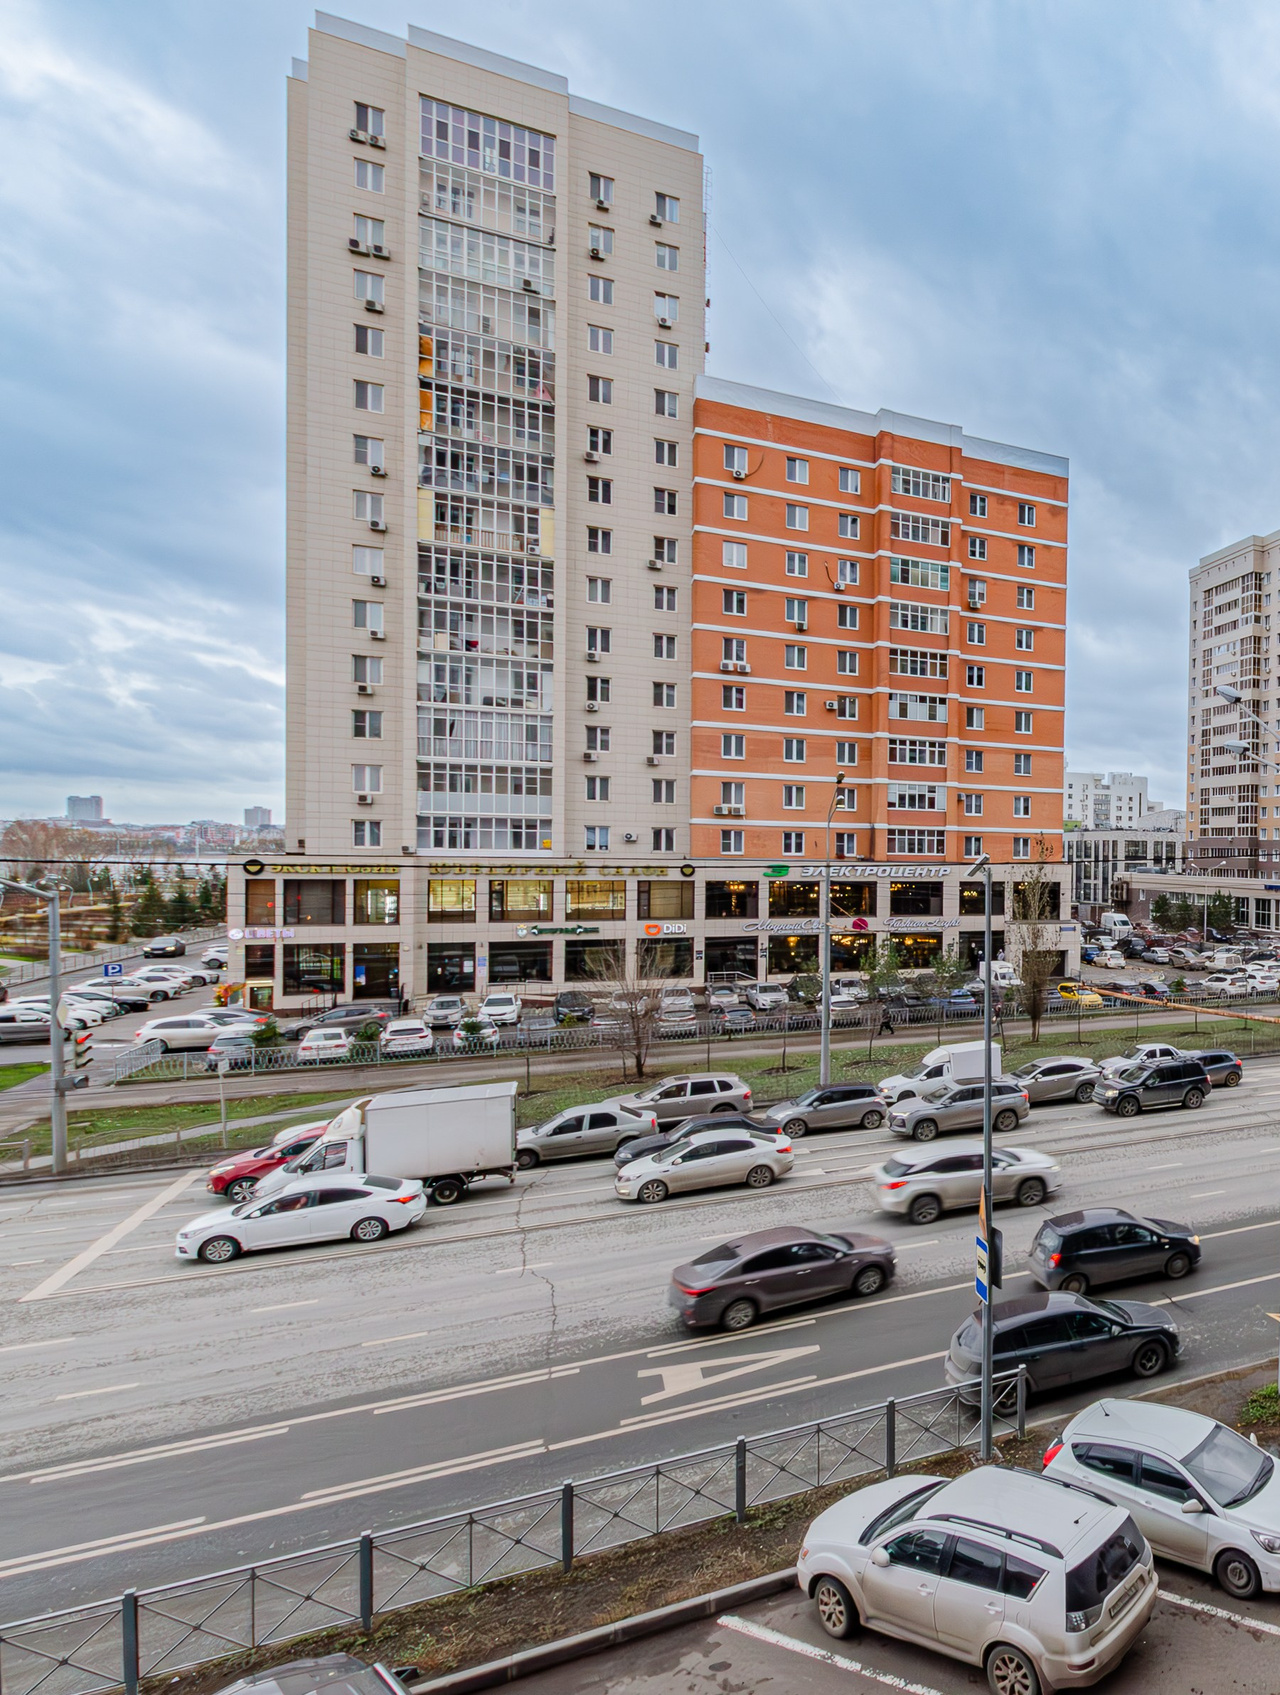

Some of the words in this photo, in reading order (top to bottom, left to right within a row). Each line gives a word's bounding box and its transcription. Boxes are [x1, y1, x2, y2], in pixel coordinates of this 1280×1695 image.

[801, 865, 951, 878] ЭЛЕКТРОЦЕНТР
[663, 923, 687, 934] DiDi
[883, 916, 926, 928] Fashion
[926, 915, 961, 931] Light
